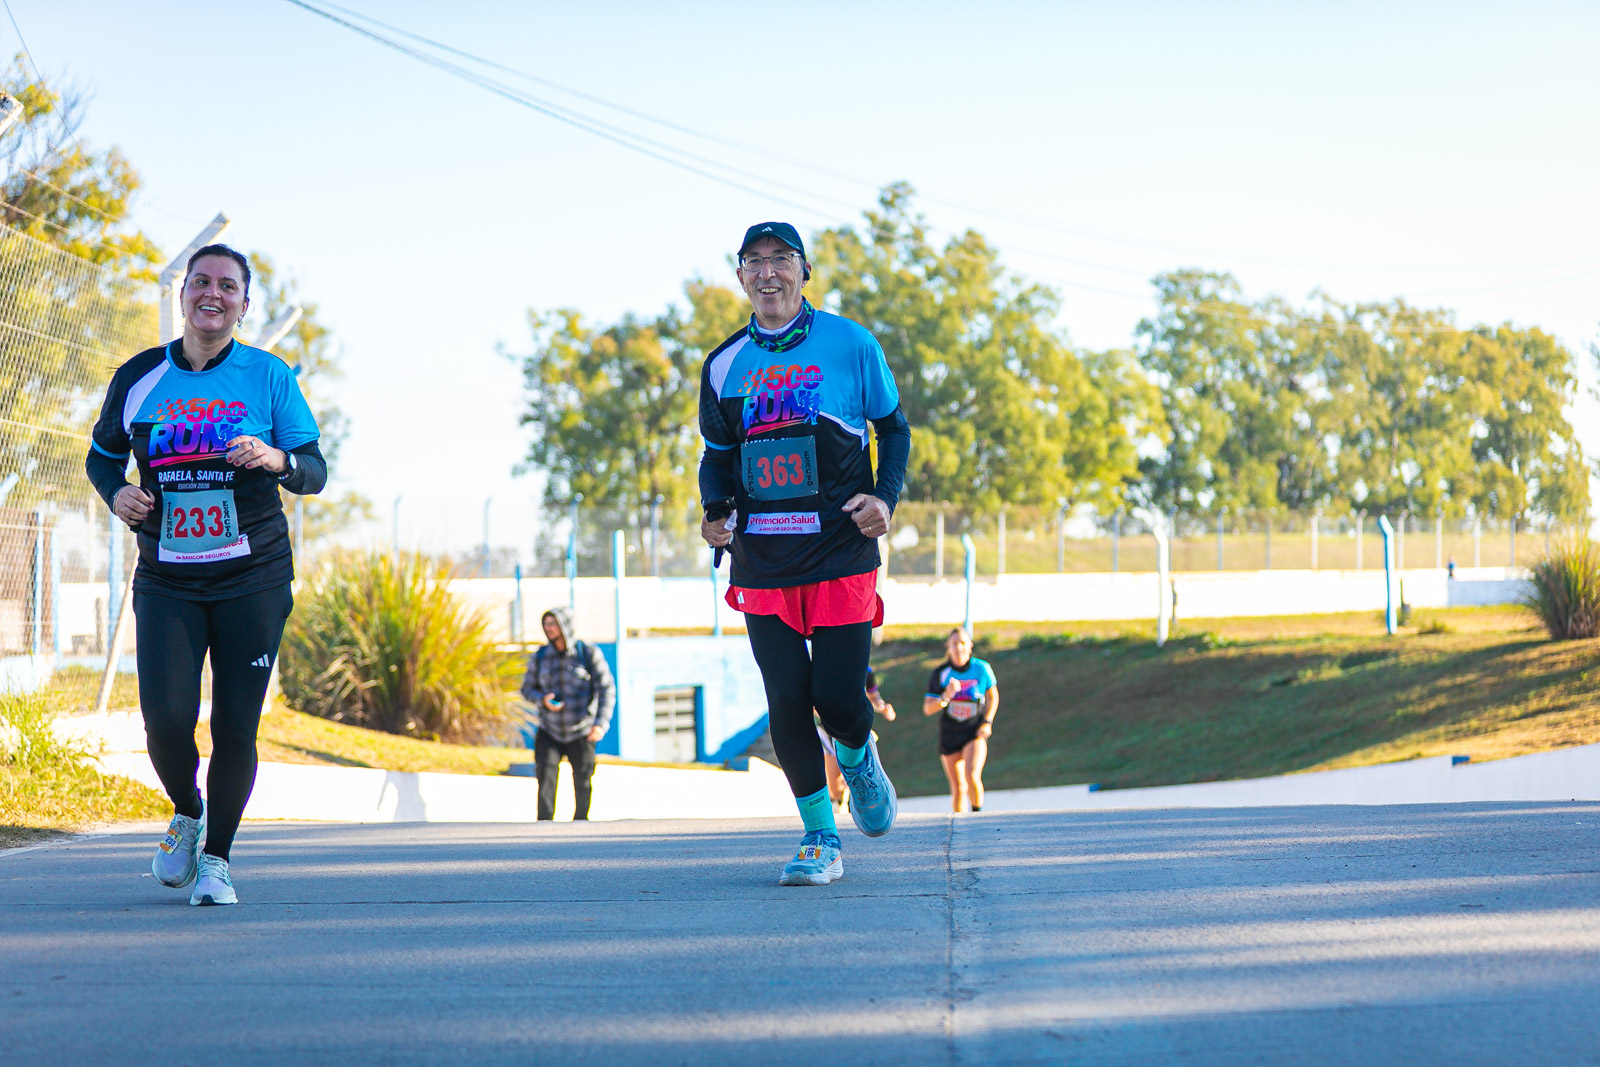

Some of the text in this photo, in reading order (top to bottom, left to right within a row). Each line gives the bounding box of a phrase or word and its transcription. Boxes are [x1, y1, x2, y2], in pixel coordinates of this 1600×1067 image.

[766, 364, 821, 391] 500
[795, 374, 824, 382] MILLAS
[185, 398, 246, 424] 500
[218, 408, 248, 417] MILLAS
[742, 390, 807, 429] RUN
[148, 423, 229, 456] RUN
[158, 470, 236, 483] RAFAELA, SANTA FE
[746, 457, 755, 492] TIEMPO
[757, 453, 804, 488] 363
[803, 450, 813, 486] EXACTO
[173, 506, 224, 538] 233
[222, 501, 232, 538] EXACTO
[791, 515, 815, 524] Salud
[205, 551, 231, 560] SEGUROS
